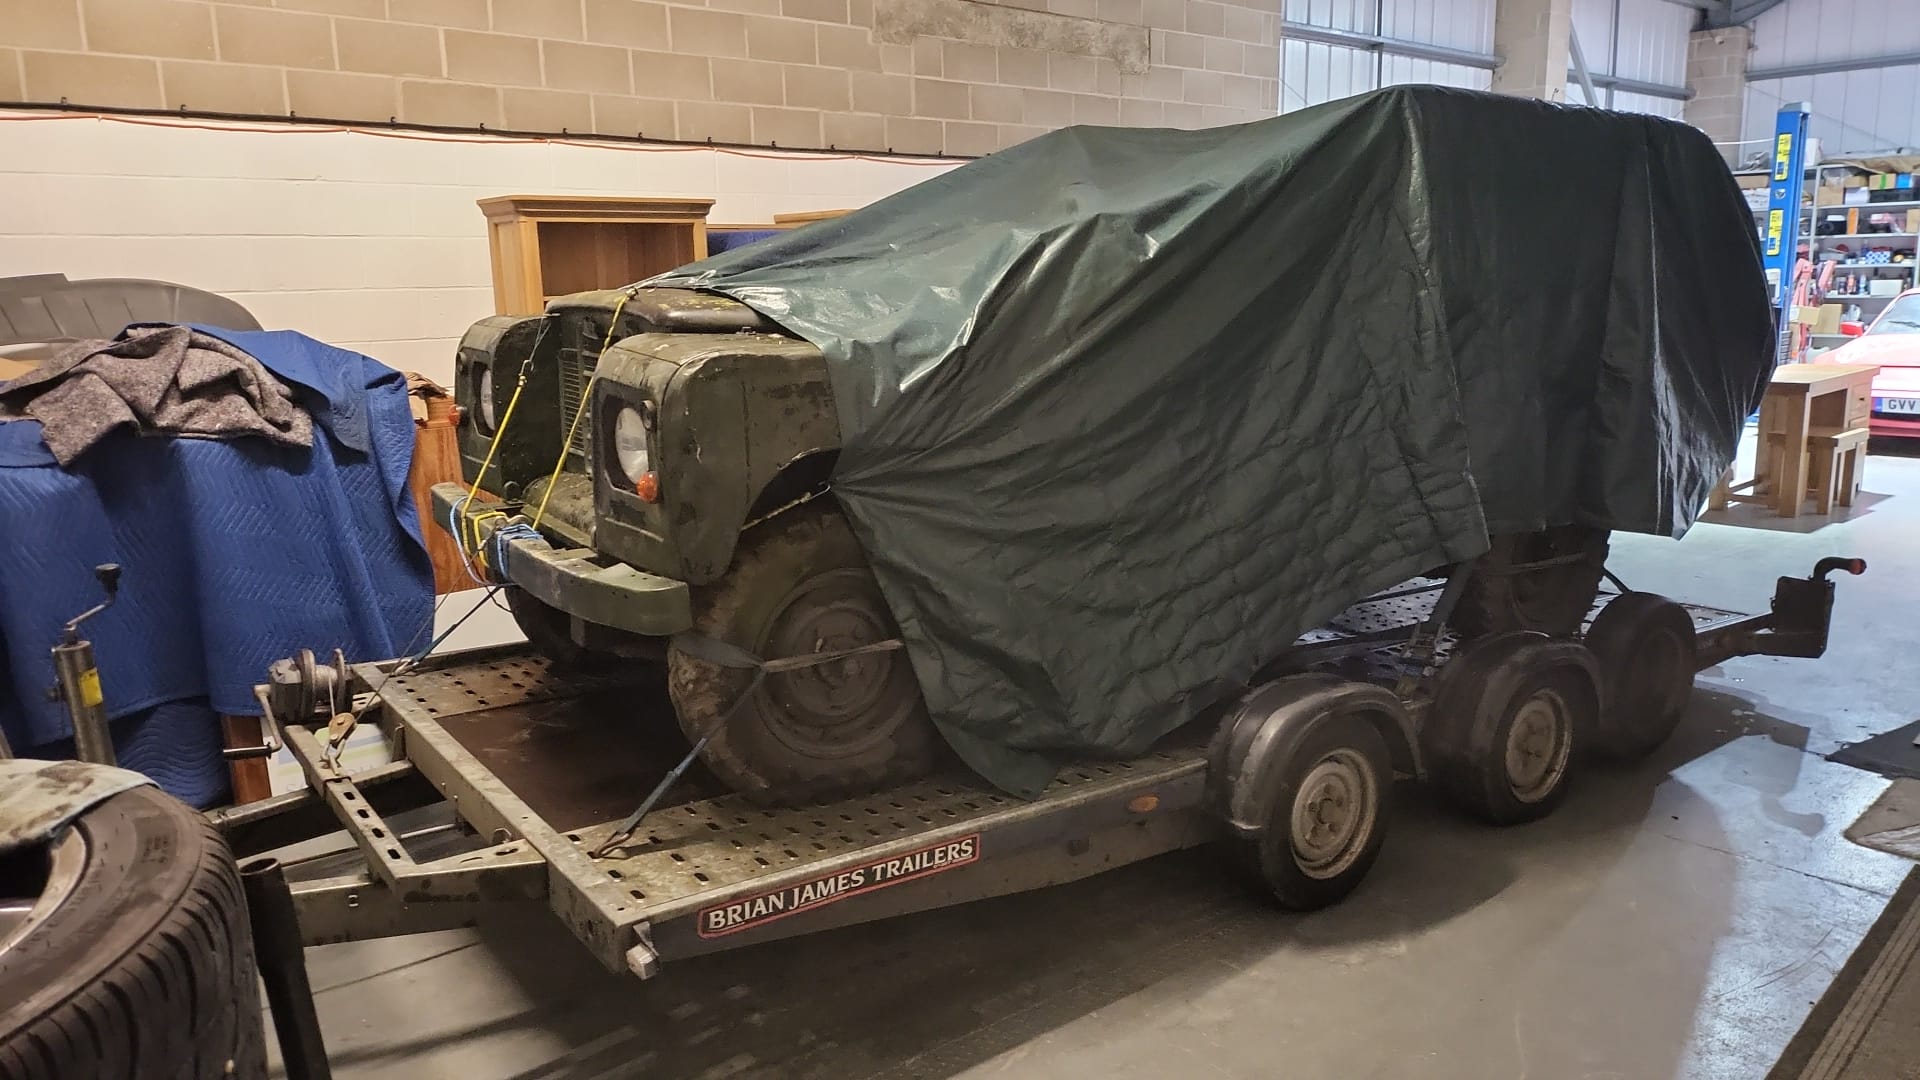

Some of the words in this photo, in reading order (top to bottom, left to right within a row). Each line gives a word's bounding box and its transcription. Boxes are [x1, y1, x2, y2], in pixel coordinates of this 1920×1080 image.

[1888, 399, 1916, 410] GVV
[708, 892, 784, 930] BRIAN
[788, 869, 865, 910] JAMES
[872, 839, 973, 882] TRAILERS
